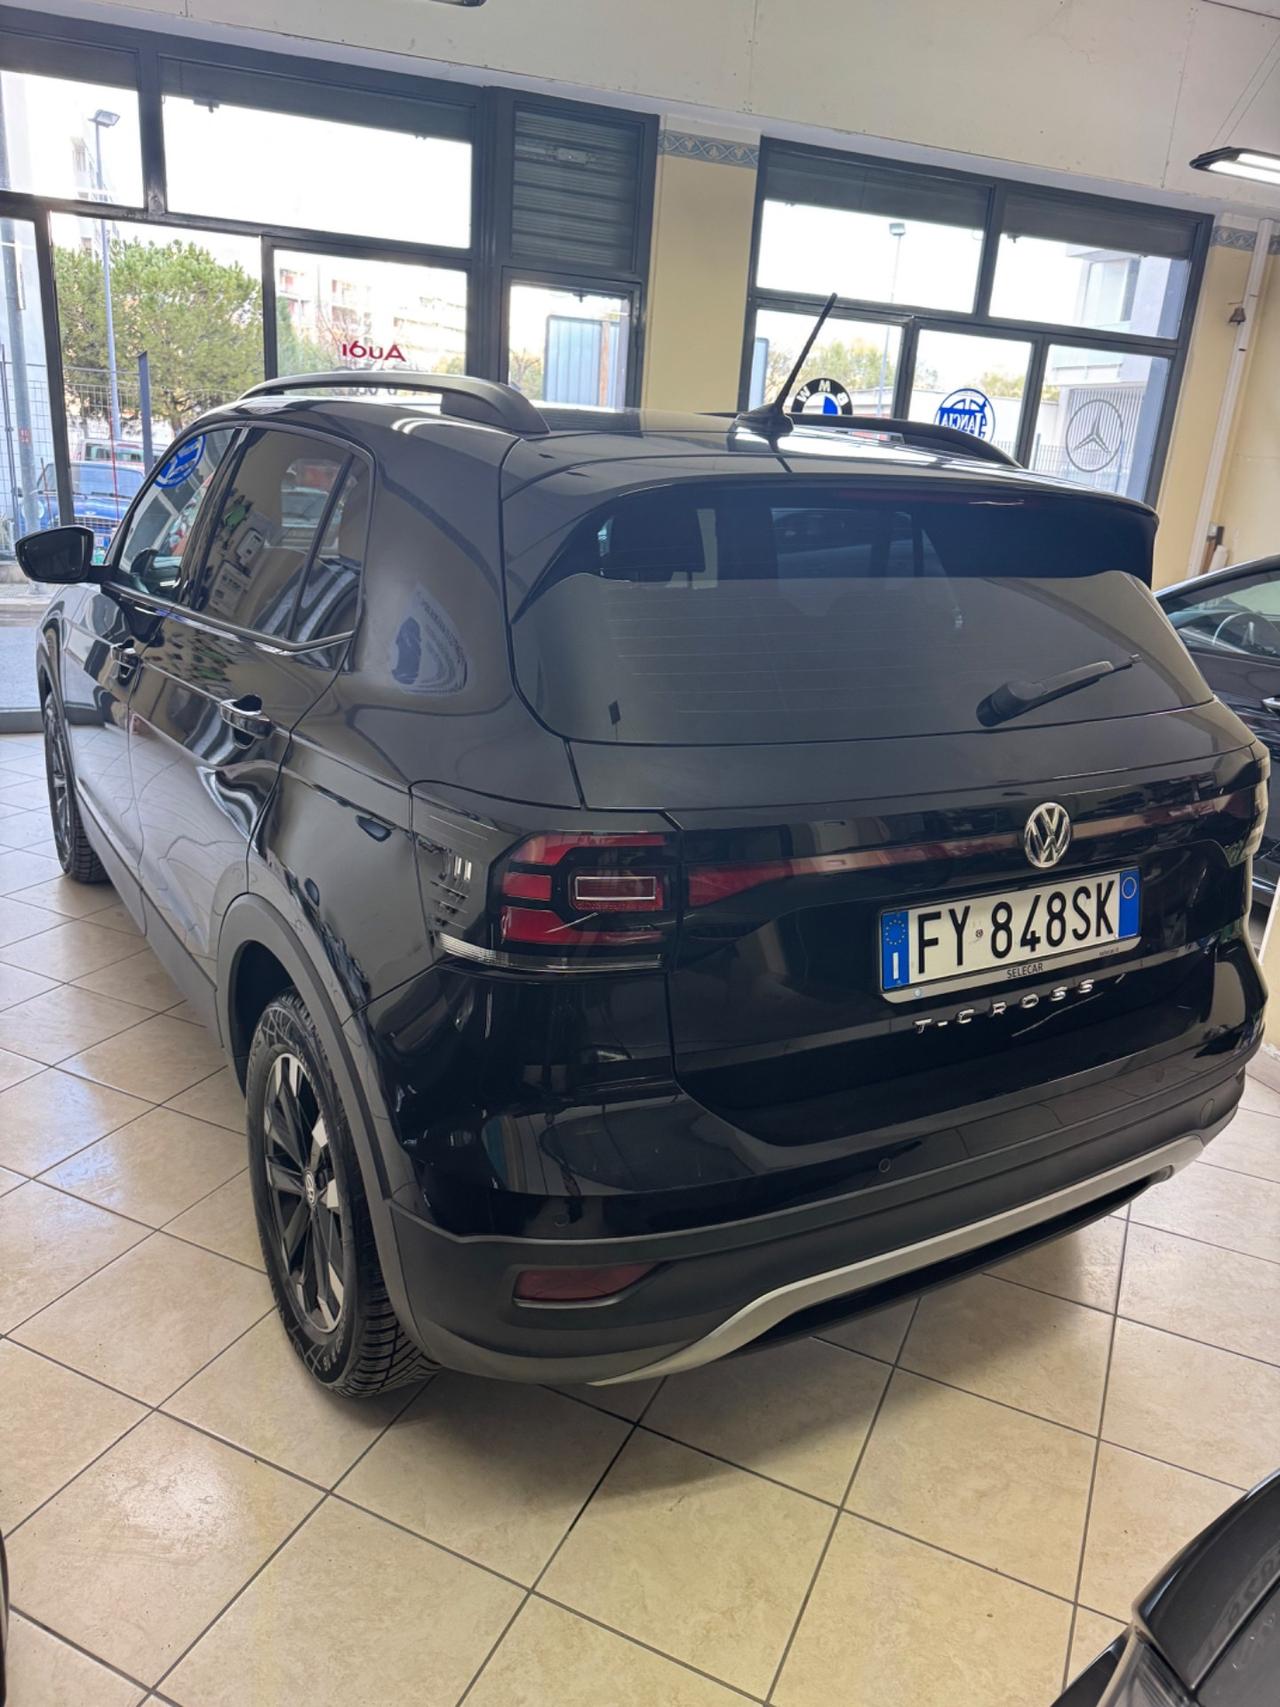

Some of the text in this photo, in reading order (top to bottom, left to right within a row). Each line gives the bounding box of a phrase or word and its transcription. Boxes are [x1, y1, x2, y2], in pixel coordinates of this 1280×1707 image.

[917, 905, 971, 974] FY
[991, 879, 1115, 959] 848SK
[1006, 962, 1044, 979] SELECAR
[914, 978, 1095, 1034] T-CROSS
